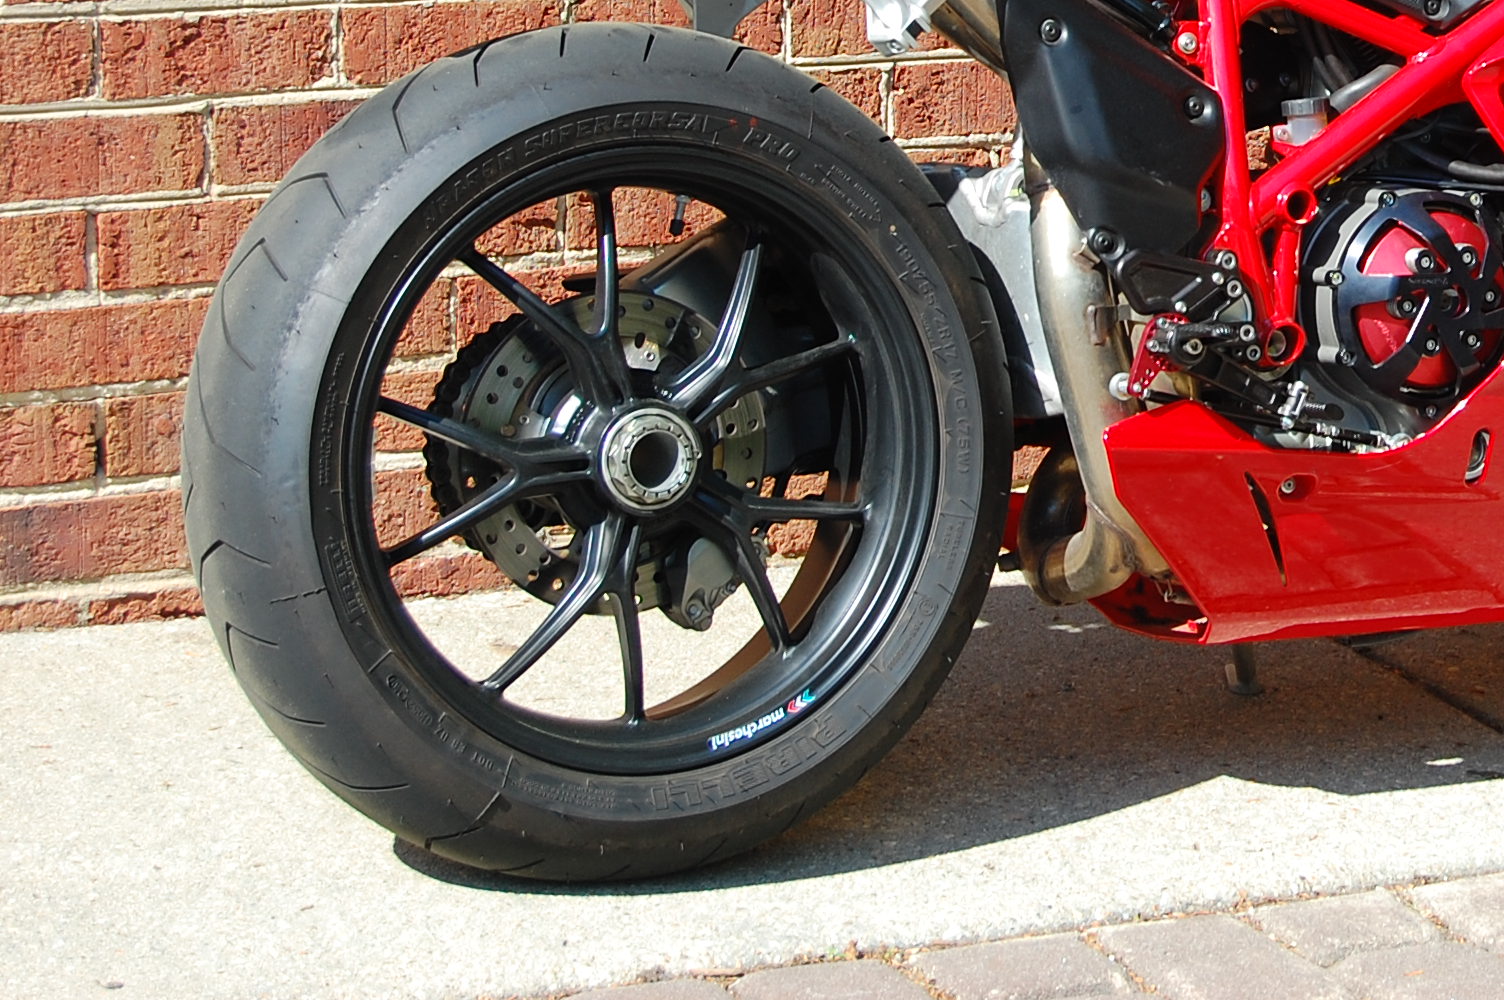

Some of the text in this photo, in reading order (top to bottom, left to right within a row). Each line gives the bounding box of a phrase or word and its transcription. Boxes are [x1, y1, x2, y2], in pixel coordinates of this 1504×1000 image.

[524, 111, 709, 157] SUPERCORSA
[743, 127, 798, 159] PRO
[710, 706, 785, 751] marchesini
[651, 713, 848, 811] PIRELLI
